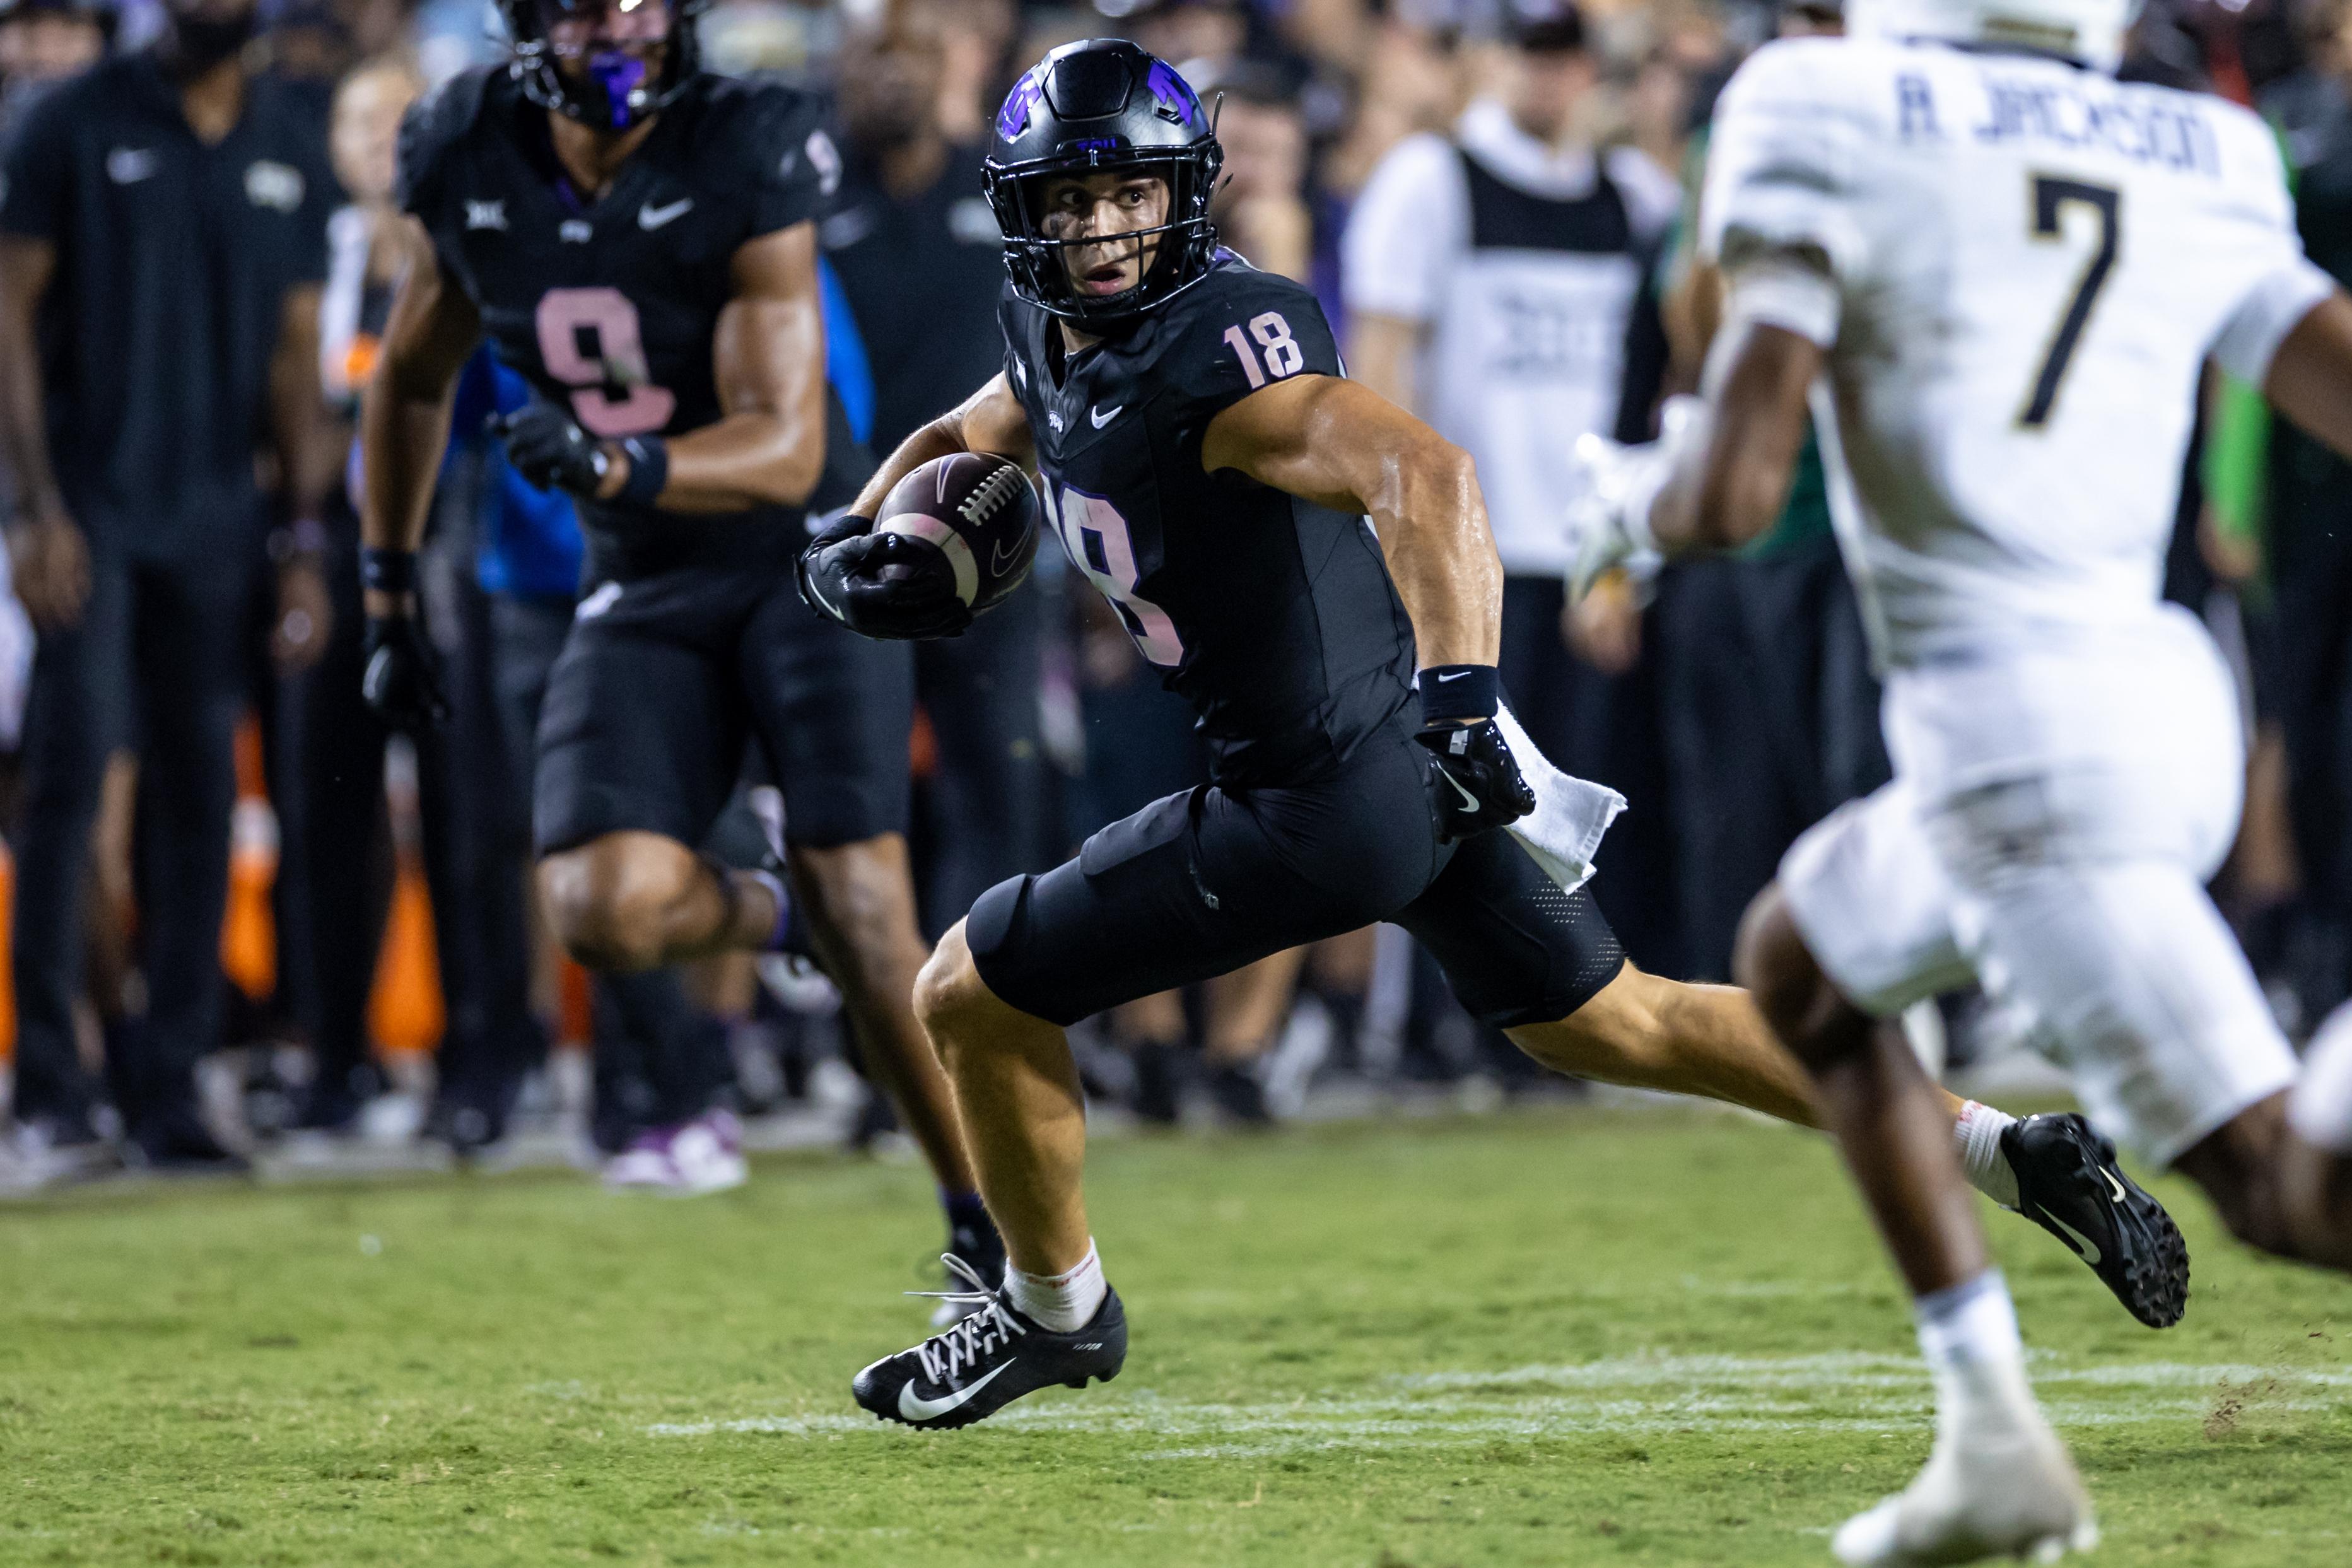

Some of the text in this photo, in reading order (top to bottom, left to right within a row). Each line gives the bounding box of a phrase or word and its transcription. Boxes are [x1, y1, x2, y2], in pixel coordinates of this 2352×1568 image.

[536, 287, 677, 436] 9
[1223, 311, 1304, 389] 18
[2013, 169, 2121, 430] 7
